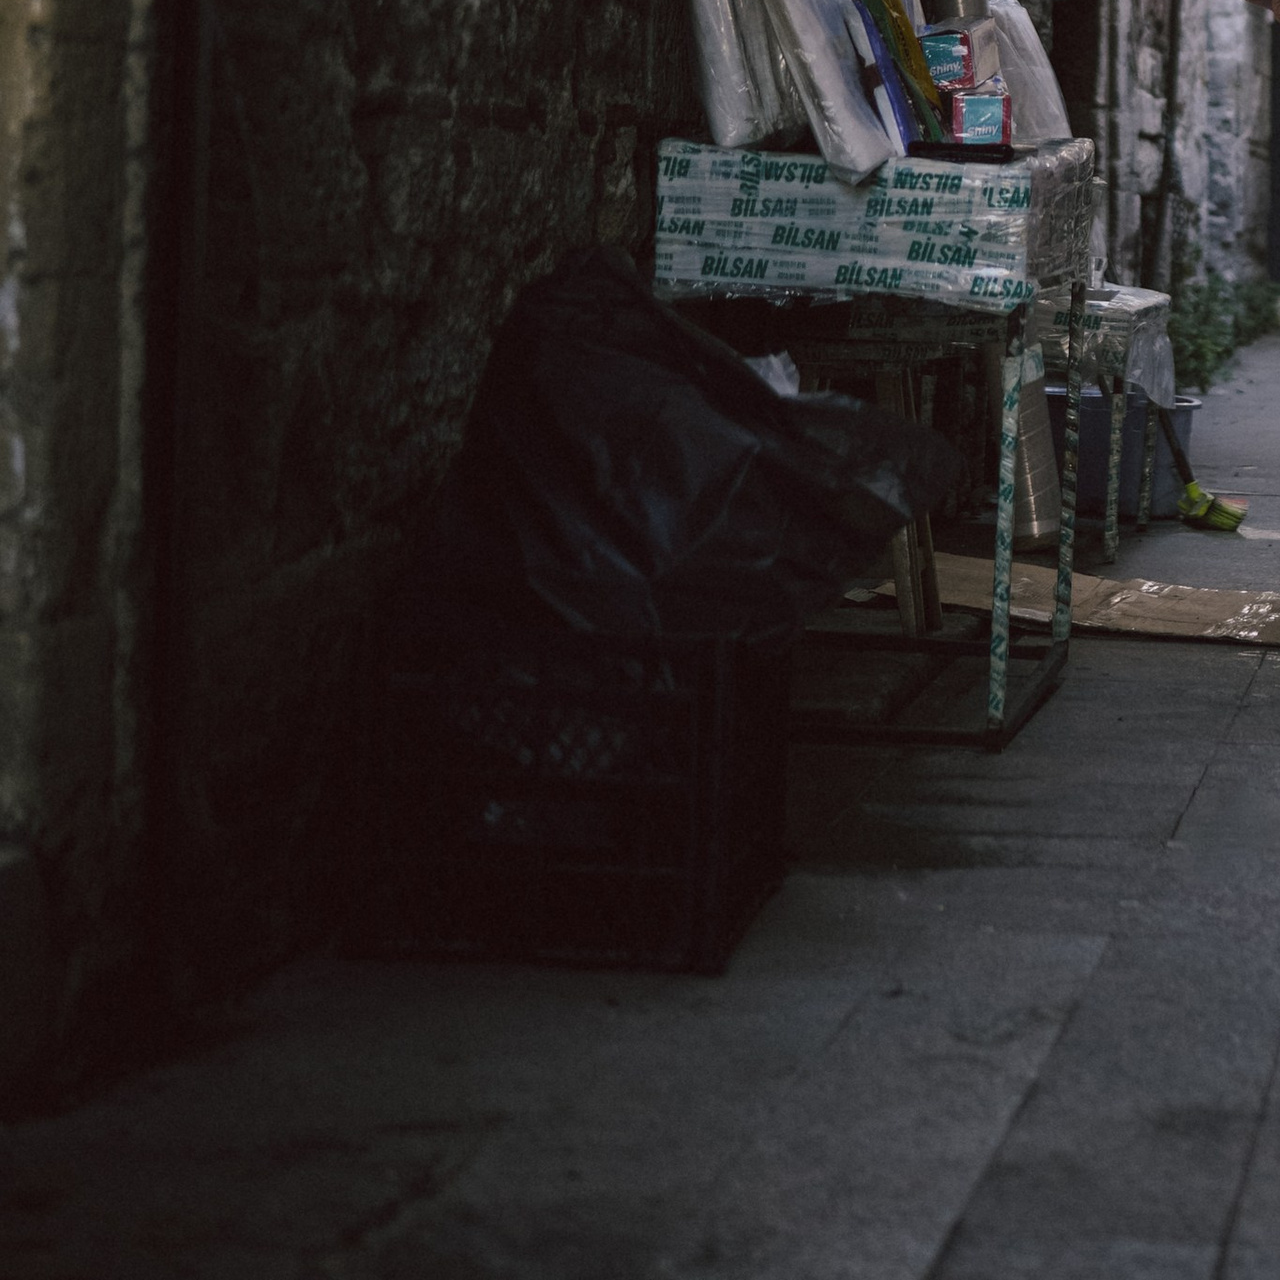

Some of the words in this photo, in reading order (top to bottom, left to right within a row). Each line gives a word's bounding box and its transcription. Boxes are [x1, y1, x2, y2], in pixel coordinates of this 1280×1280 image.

[657, 217, 706, 237] LSAN
[771, 221, 842, 251] BİLSAN
[701, 250, 770, 279] BİLSAN
[906, 236, 979, 268] BİLSAN
[834, 260, 904, 289] BİLSAN
